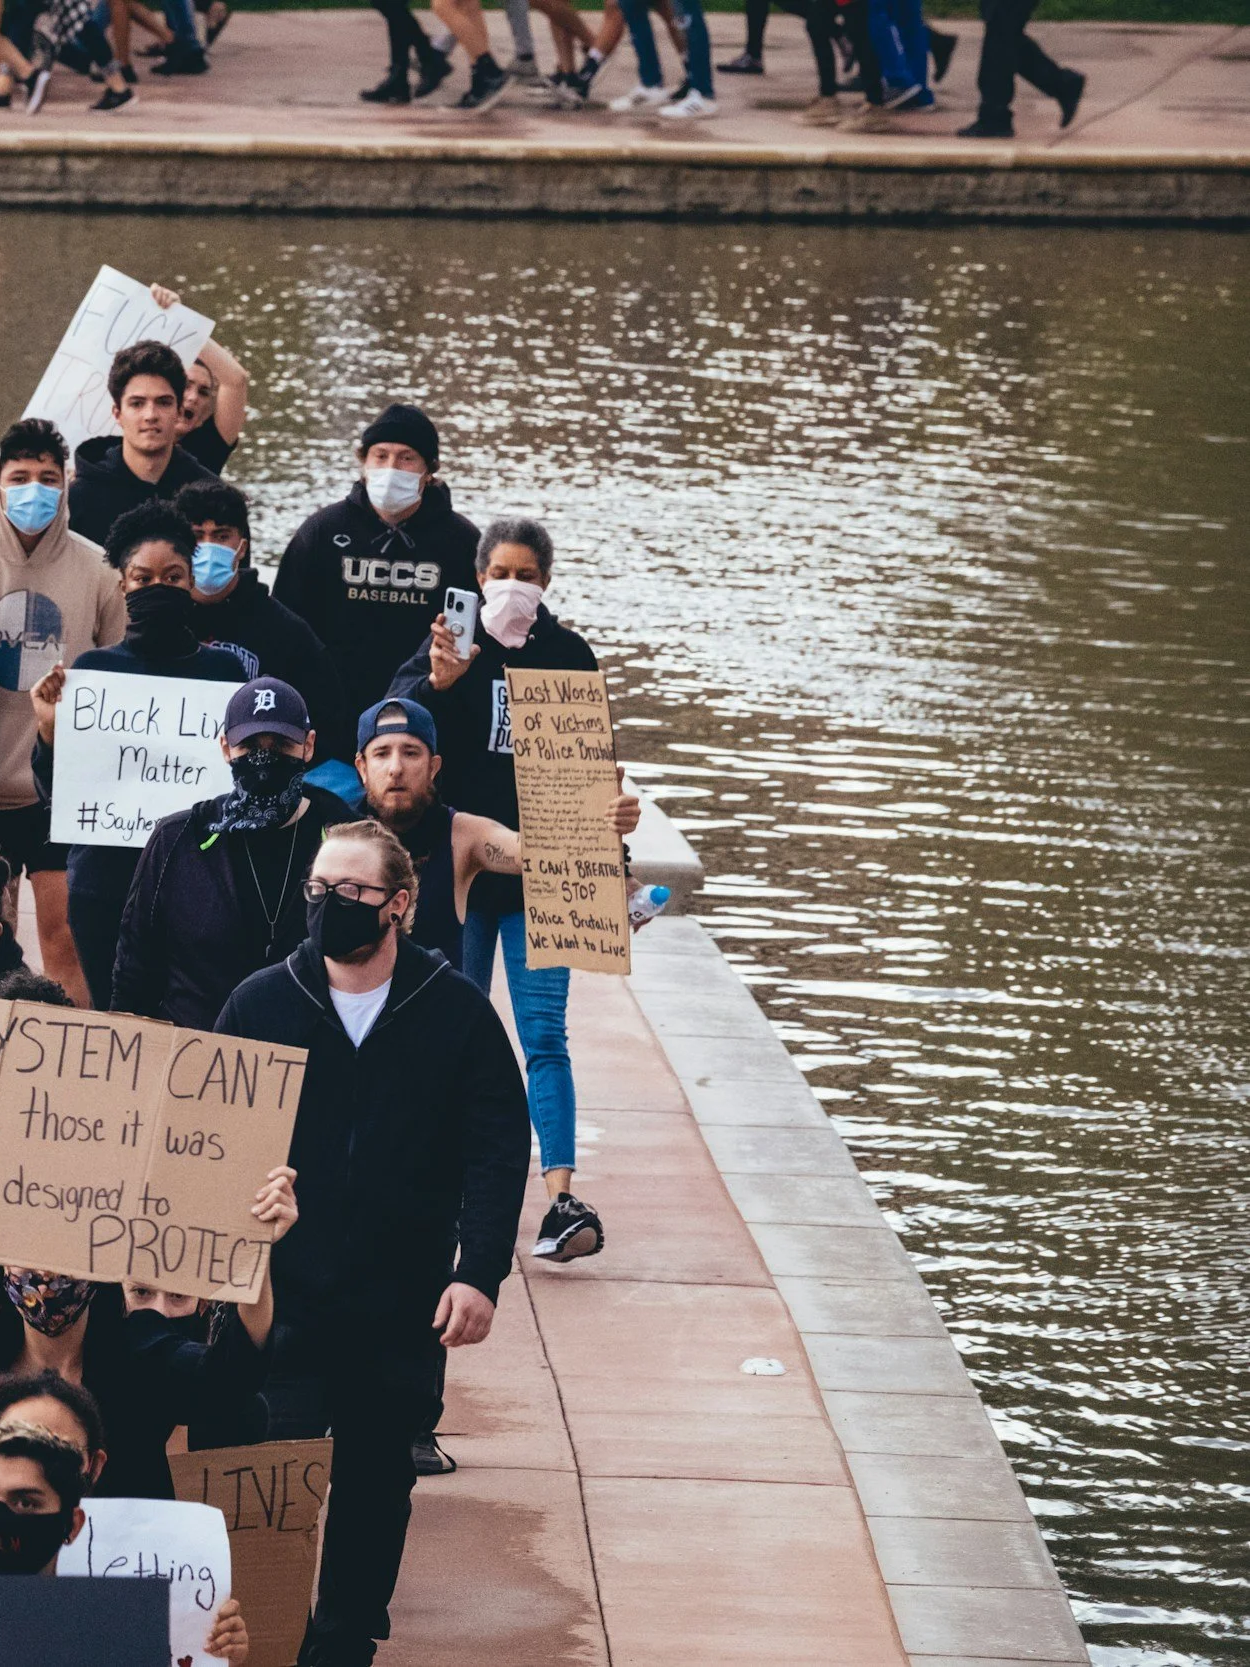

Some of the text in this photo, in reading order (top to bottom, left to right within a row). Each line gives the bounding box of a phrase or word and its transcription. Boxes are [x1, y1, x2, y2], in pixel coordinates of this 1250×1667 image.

[73, 283, 198, 355] FUCK
[45, 352, 118, 436] TRU
[342, 556, 441, 590] UCCS
[348, 587, 428, 604] BASEBALL
[508, 673, 550, 702] Last
[554, 677, 603, 703] Words
[73, 686, 225, 740] Black Liv
[118, 745, 207, 785] Matter
[535, 737, 574, 760] Police
[562, 881, 596, 903] STOP
[529, 907, 564, 925] Police
[569, 910, 619, 936] Brutality
[529, 932, 626, 957] We Want to Live
[167, 1038, 307, 1110] CAN'T
[19, 1086, 105, 1143] those
[120, 1110, 144, 1147] it
[165, 1126, 225, 1161] was
[3, 1165, 124, 1222] designed
[138, 1182, 170, 1217] to
[89, 1214, 272, 1291] PROTECT
[88, 1516, 216, 1612] letting
